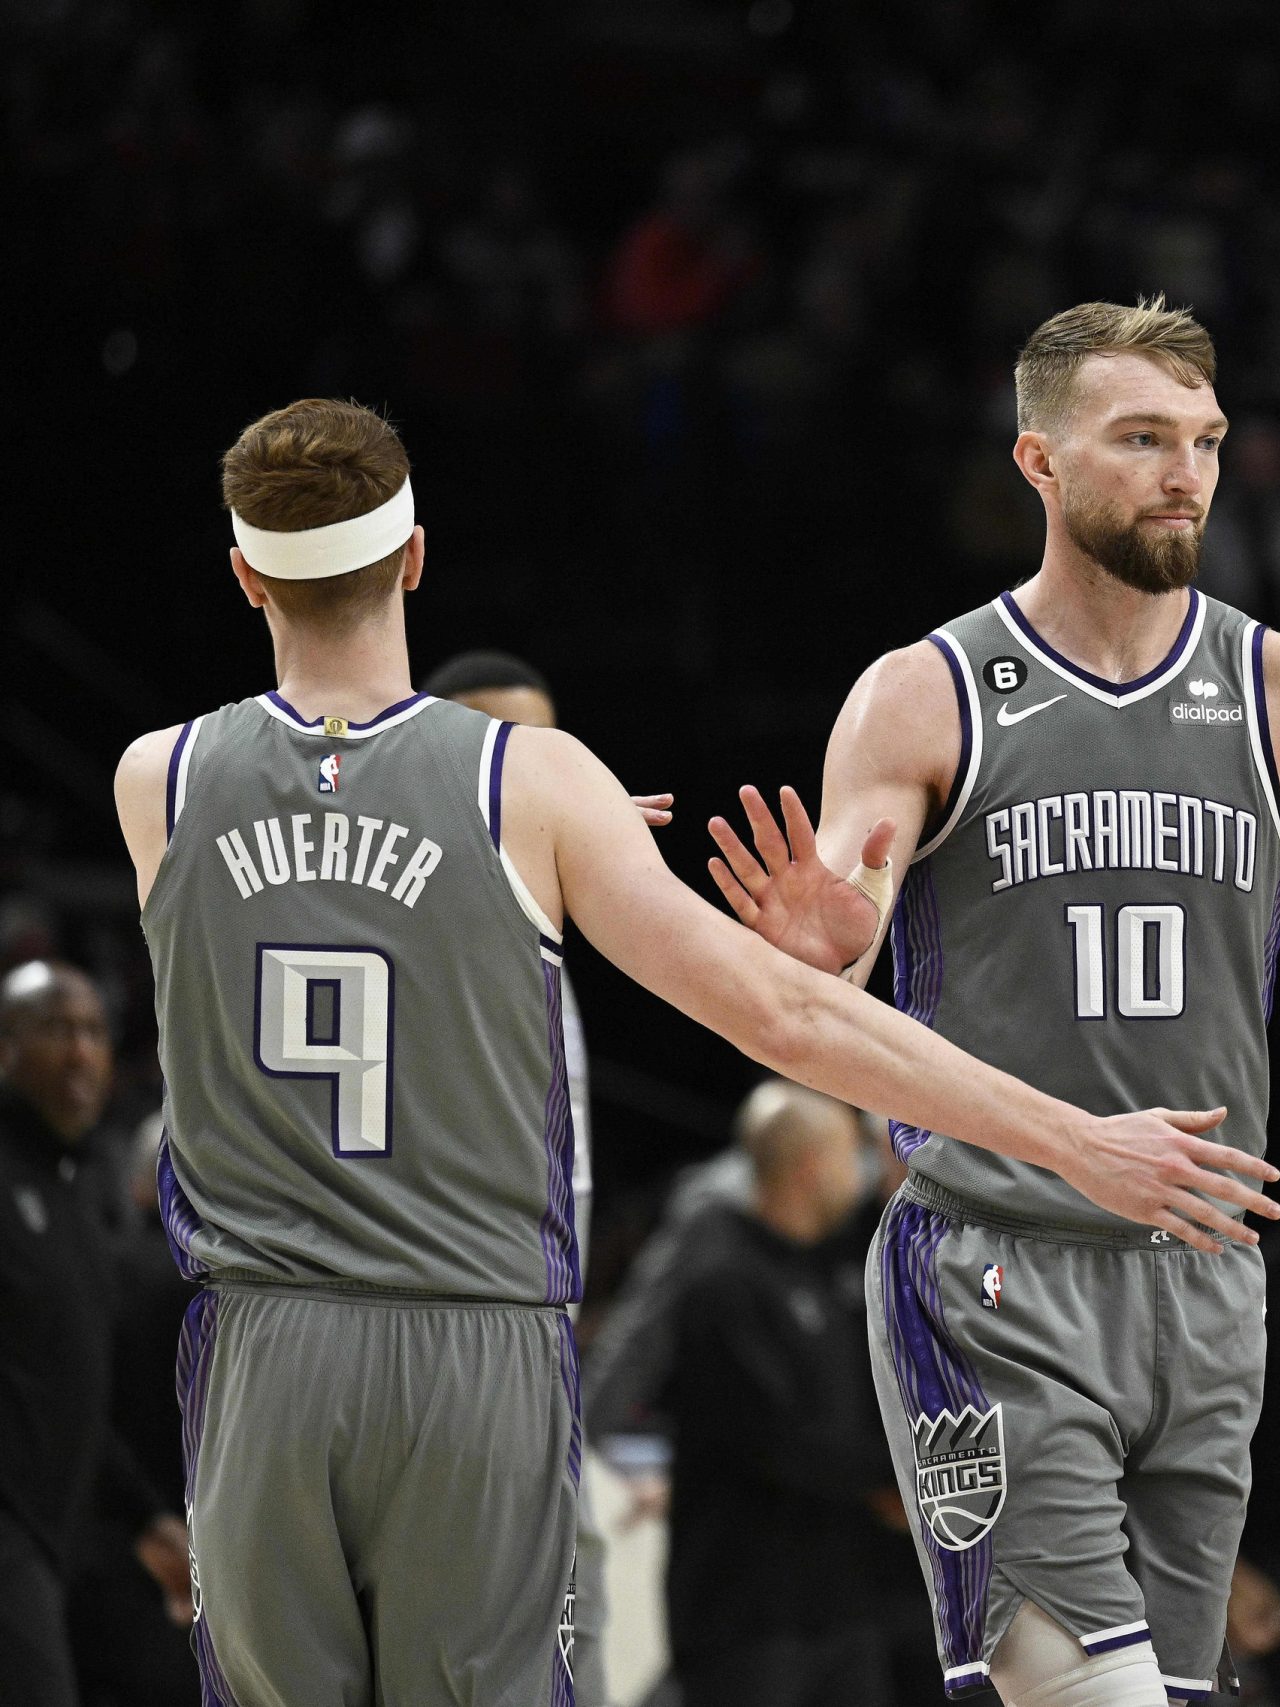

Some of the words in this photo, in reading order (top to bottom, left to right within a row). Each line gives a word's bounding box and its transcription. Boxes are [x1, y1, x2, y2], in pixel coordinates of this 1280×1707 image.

[994, 660, 1017, 689] 6
[1172, 704, 1243, 724] dialpad
[216, 812, 443, 908] HUERTER
[985, 789, 1258, 895] SACRAMENTO
[1064, 902, 1187, 1022] 10
[254, 942, 395, 1159] 9
[918, 1446, 998, 1468] SACRAMENTO
[918, 1460, 1003, 1500] KINGS
